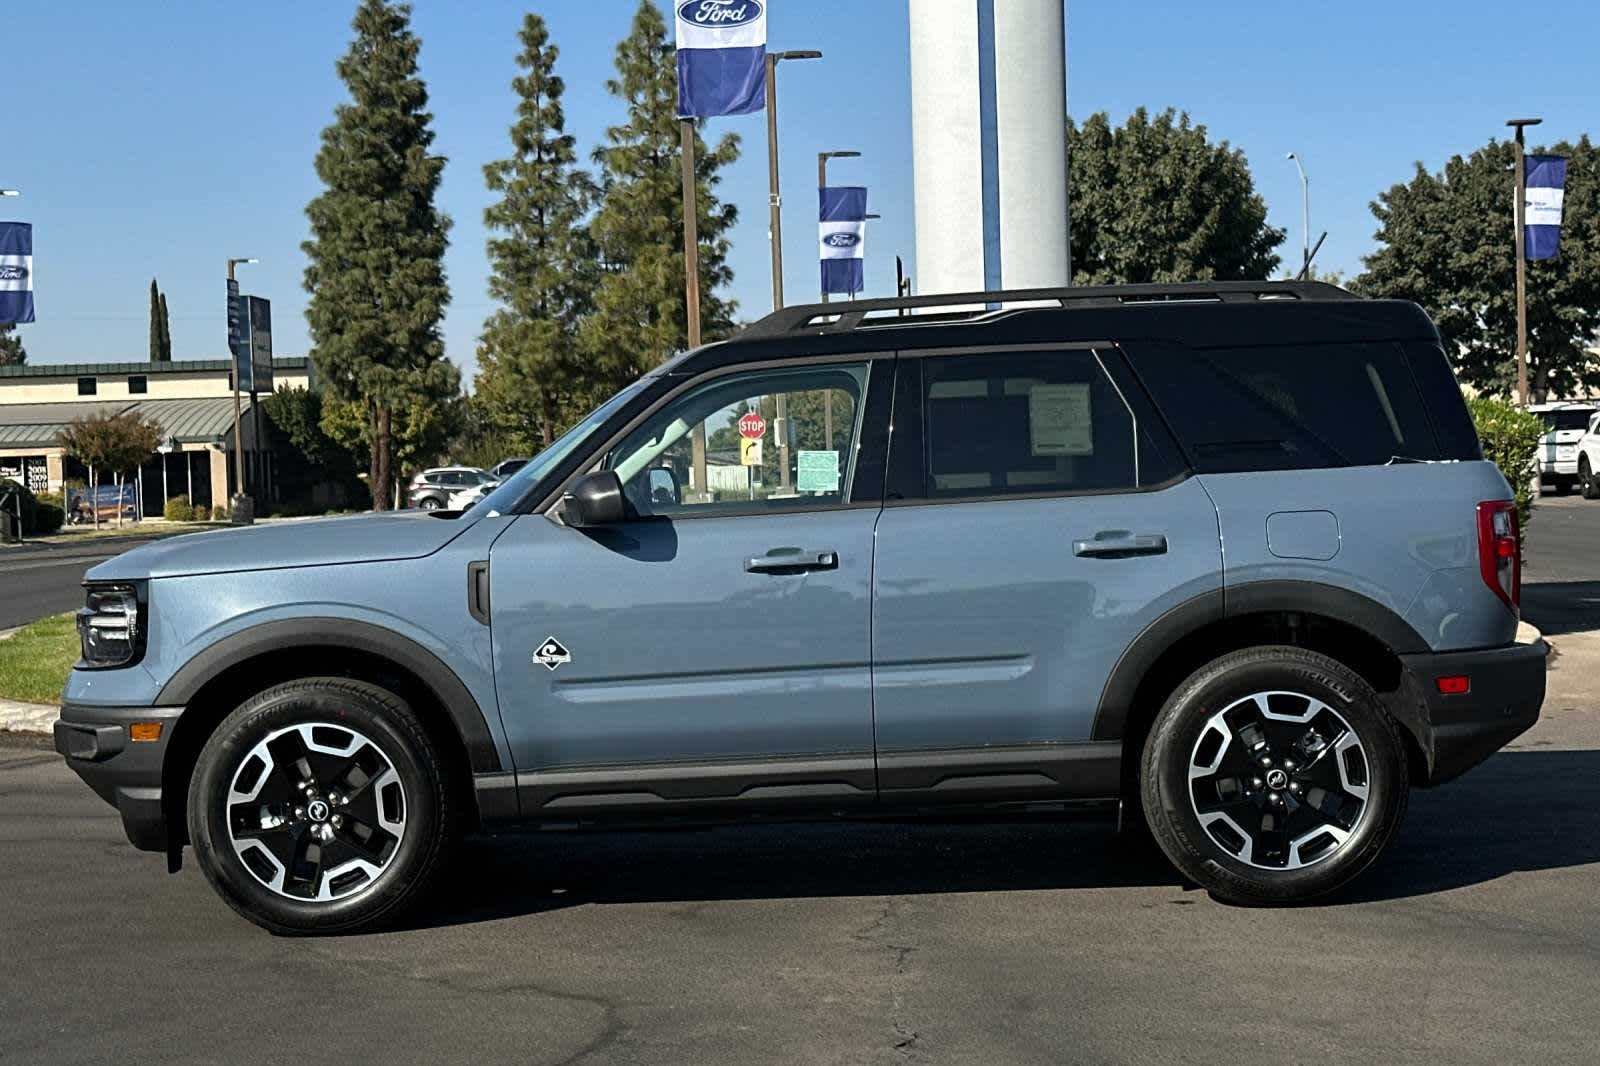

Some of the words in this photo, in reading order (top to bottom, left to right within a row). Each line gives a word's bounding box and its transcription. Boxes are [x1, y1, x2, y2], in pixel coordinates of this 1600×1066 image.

[695, 0, 747, 21] Ford
[830, 234, 855, 246] Ford
[741, 421, 763, 431] STOP
